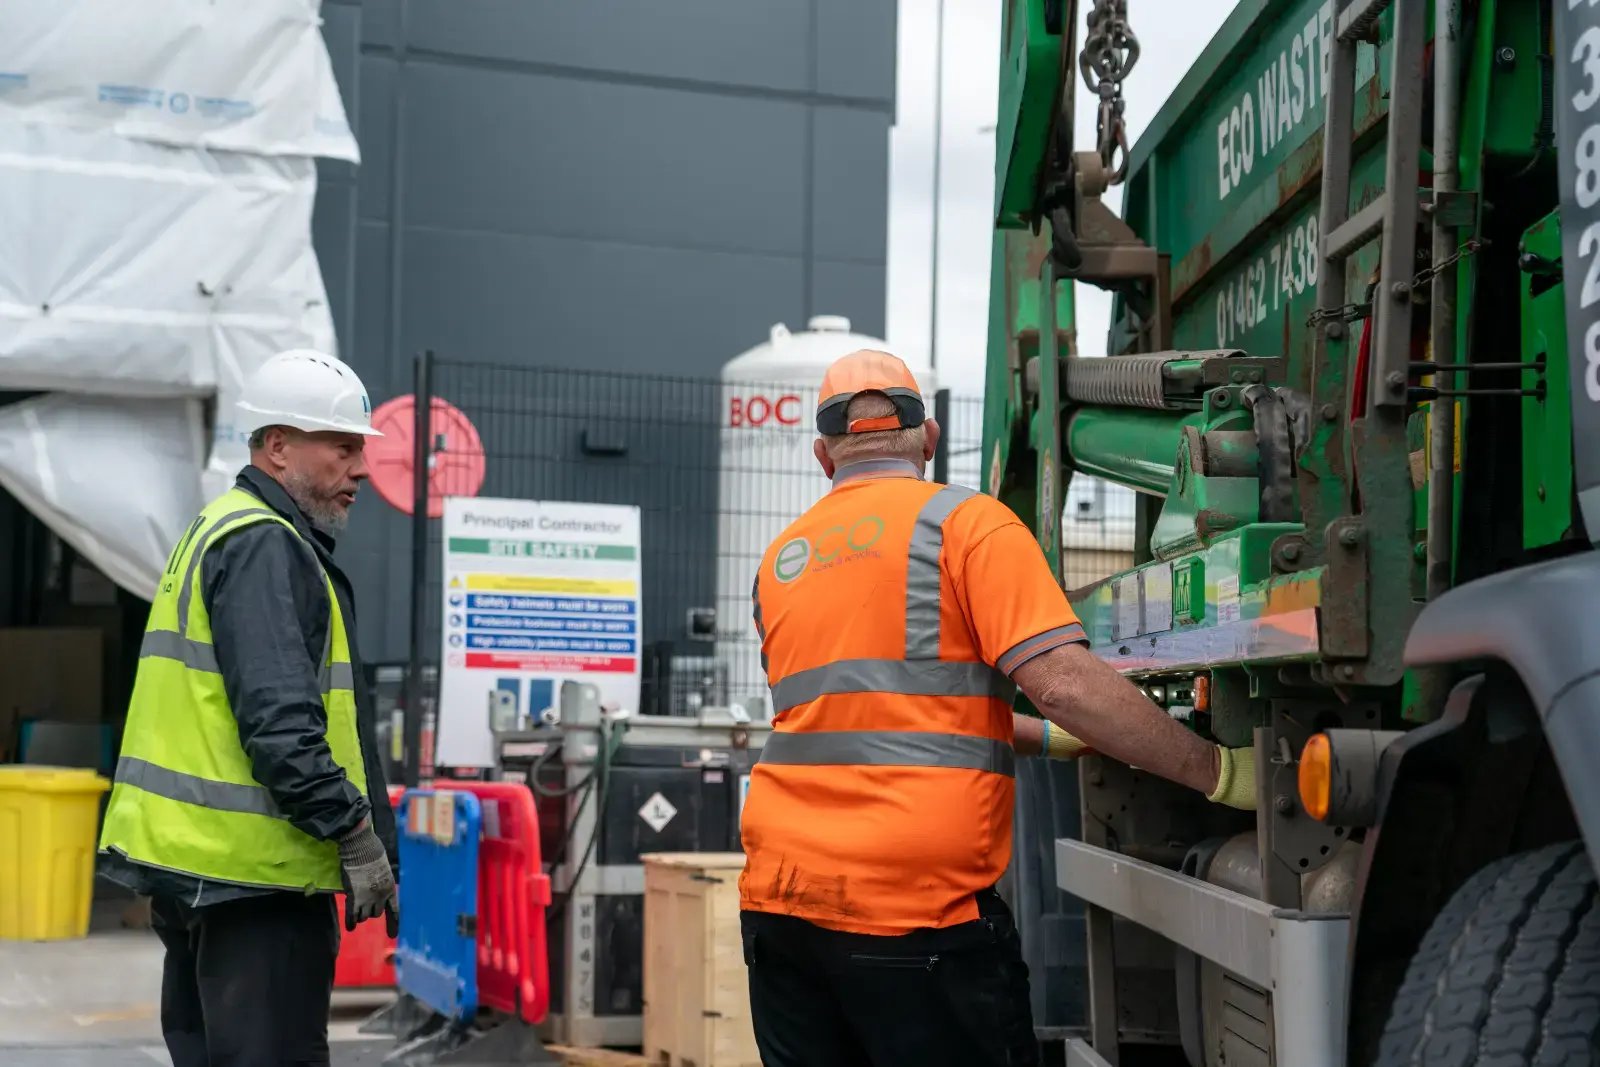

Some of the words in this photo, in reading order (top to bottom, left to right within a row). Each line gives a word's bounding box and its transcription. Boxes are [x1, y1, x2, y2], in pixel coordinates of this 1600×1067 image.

[1218, 92, 1254, 200] ECO
[1258, 0, 1331, 157] WASTE
[1568, 0, 1600, 402] 3828
[1217, 257, 1267, 349] 01462
[1270, 215, 1320, 311] 7438
[729, 395, 801, 427] BOC
[463, 513, 534, 531] Principal
[539, 517, 622, 534] Contractor
[489, 540, 525, 556] SITE
[531, 541, 599, 559] SAFETY
[775, 515, 885, 582] eco
[475, 596, 510, 609] Safety
[512, 598, 555, 610] helmets
[558, 600, 584, 610] must
[586, 601, 599, 611] be
[602, 604, 628, 612] worn
[473, 615, 522, 628] Protective
[567, 620, 589, 629] must
[606, 623, 629, 631] worn
[608, 643, 631, 651] worn
